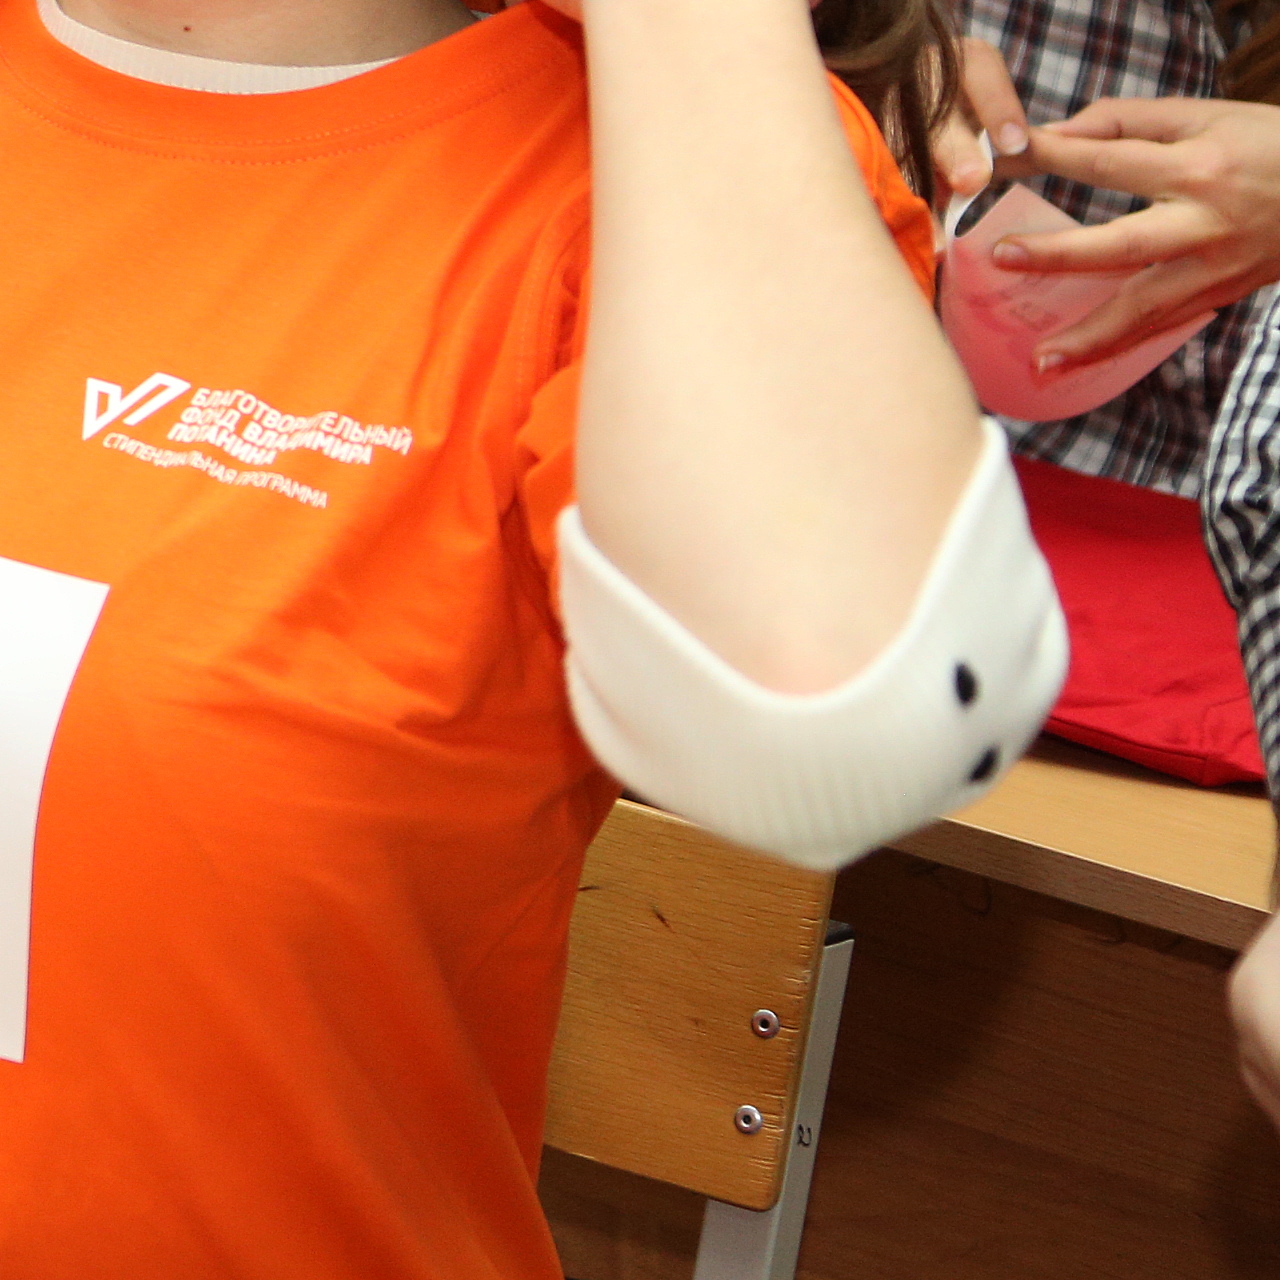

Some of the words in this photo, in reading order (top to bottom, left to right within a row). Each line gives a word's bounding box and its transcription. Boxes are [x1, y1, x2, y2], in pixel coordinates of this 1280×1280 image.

[167, 423, 278, 465] ПОТАНИНА
[180, 406, 241, 432] ФОНД
[242, 422, 373, 465] ВЛАДИМИРА
[191, 387, 414, 456] БЛАГОТВОРИТЕЛЬНЫЙ
[102, 432, 238, 485] СТИПЕНДИАЛЬНАЯ
[237, 470, 329, 509] ПРОГРАММА
